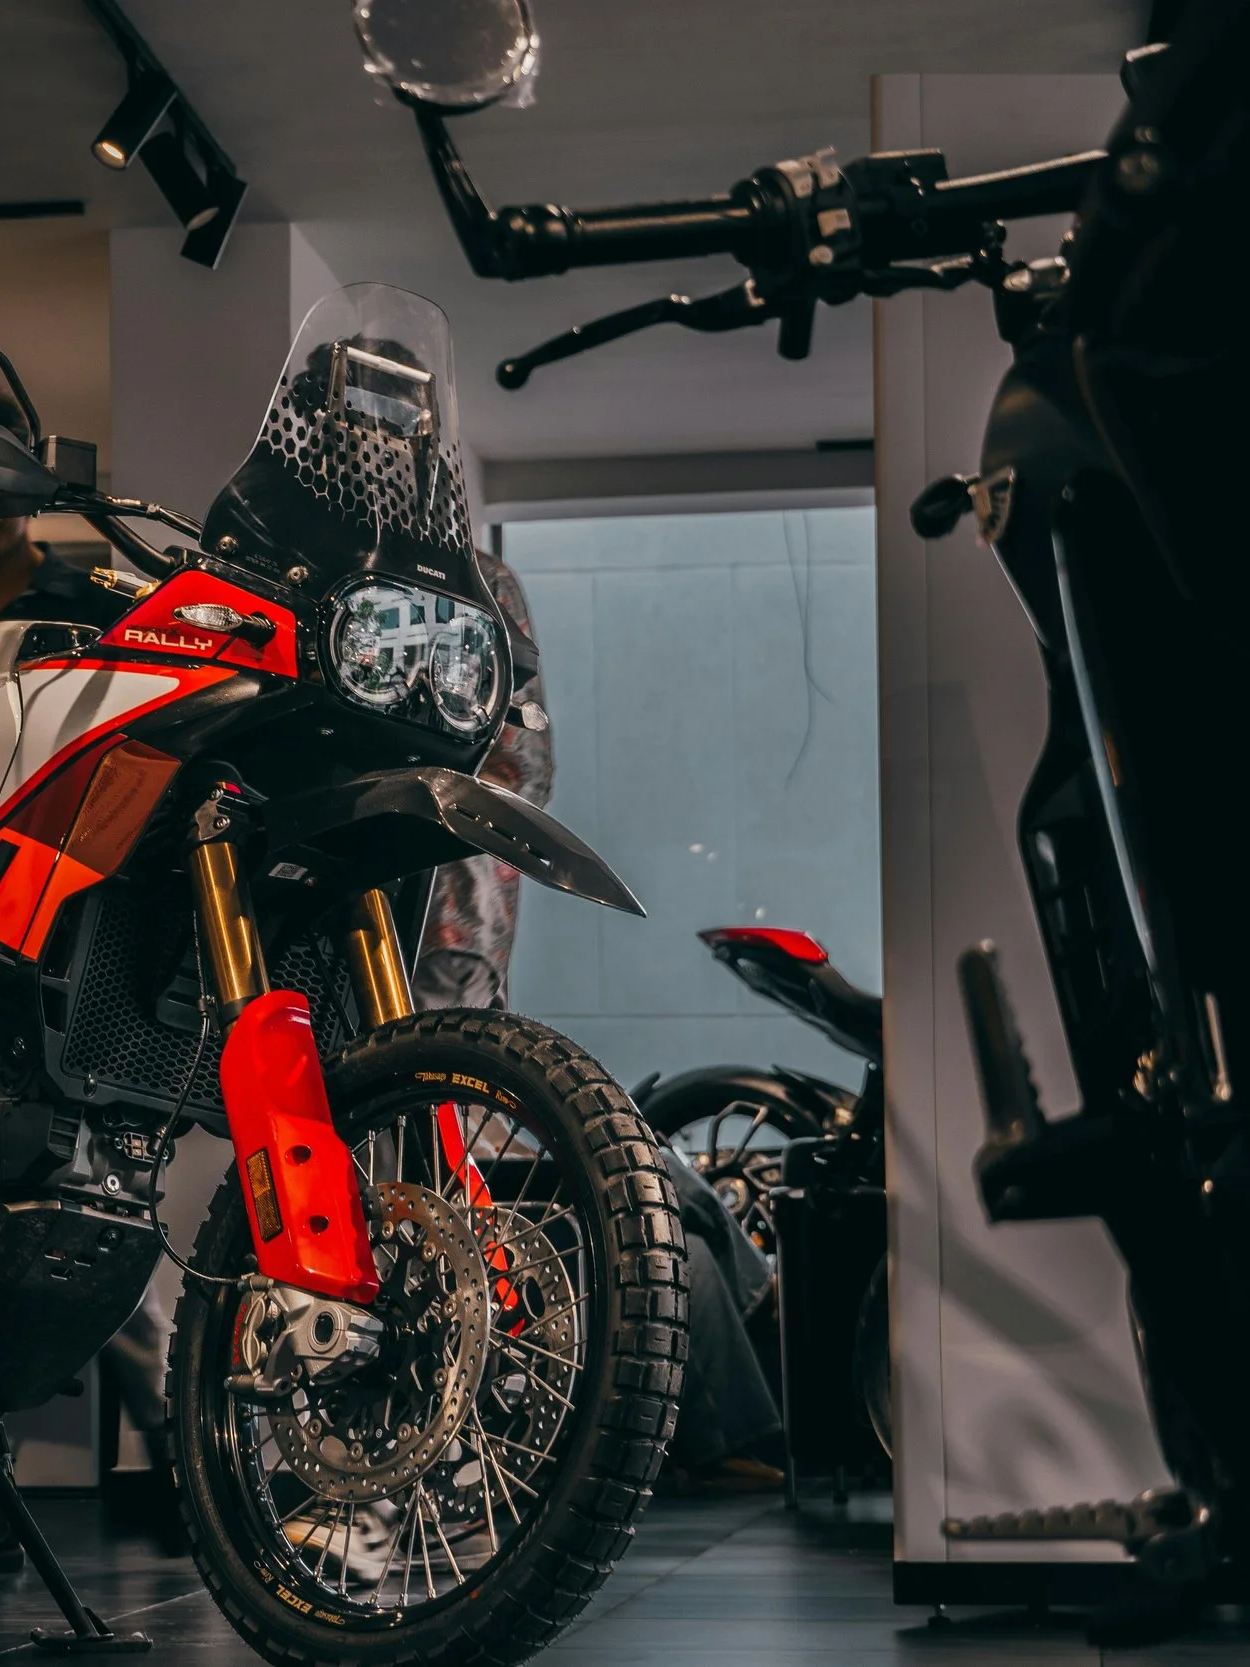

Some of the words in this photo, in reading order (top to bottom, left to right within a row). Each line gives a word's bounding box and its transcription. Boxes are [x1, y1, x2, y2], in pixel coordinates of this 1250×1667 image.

[416, 564, 446, 580] DUCATI
[124, 629, 213, 651] RALLY
[451, 1072, 491, 1094] EXCEL
[275, 1584, 314, 1615] EXCEL
